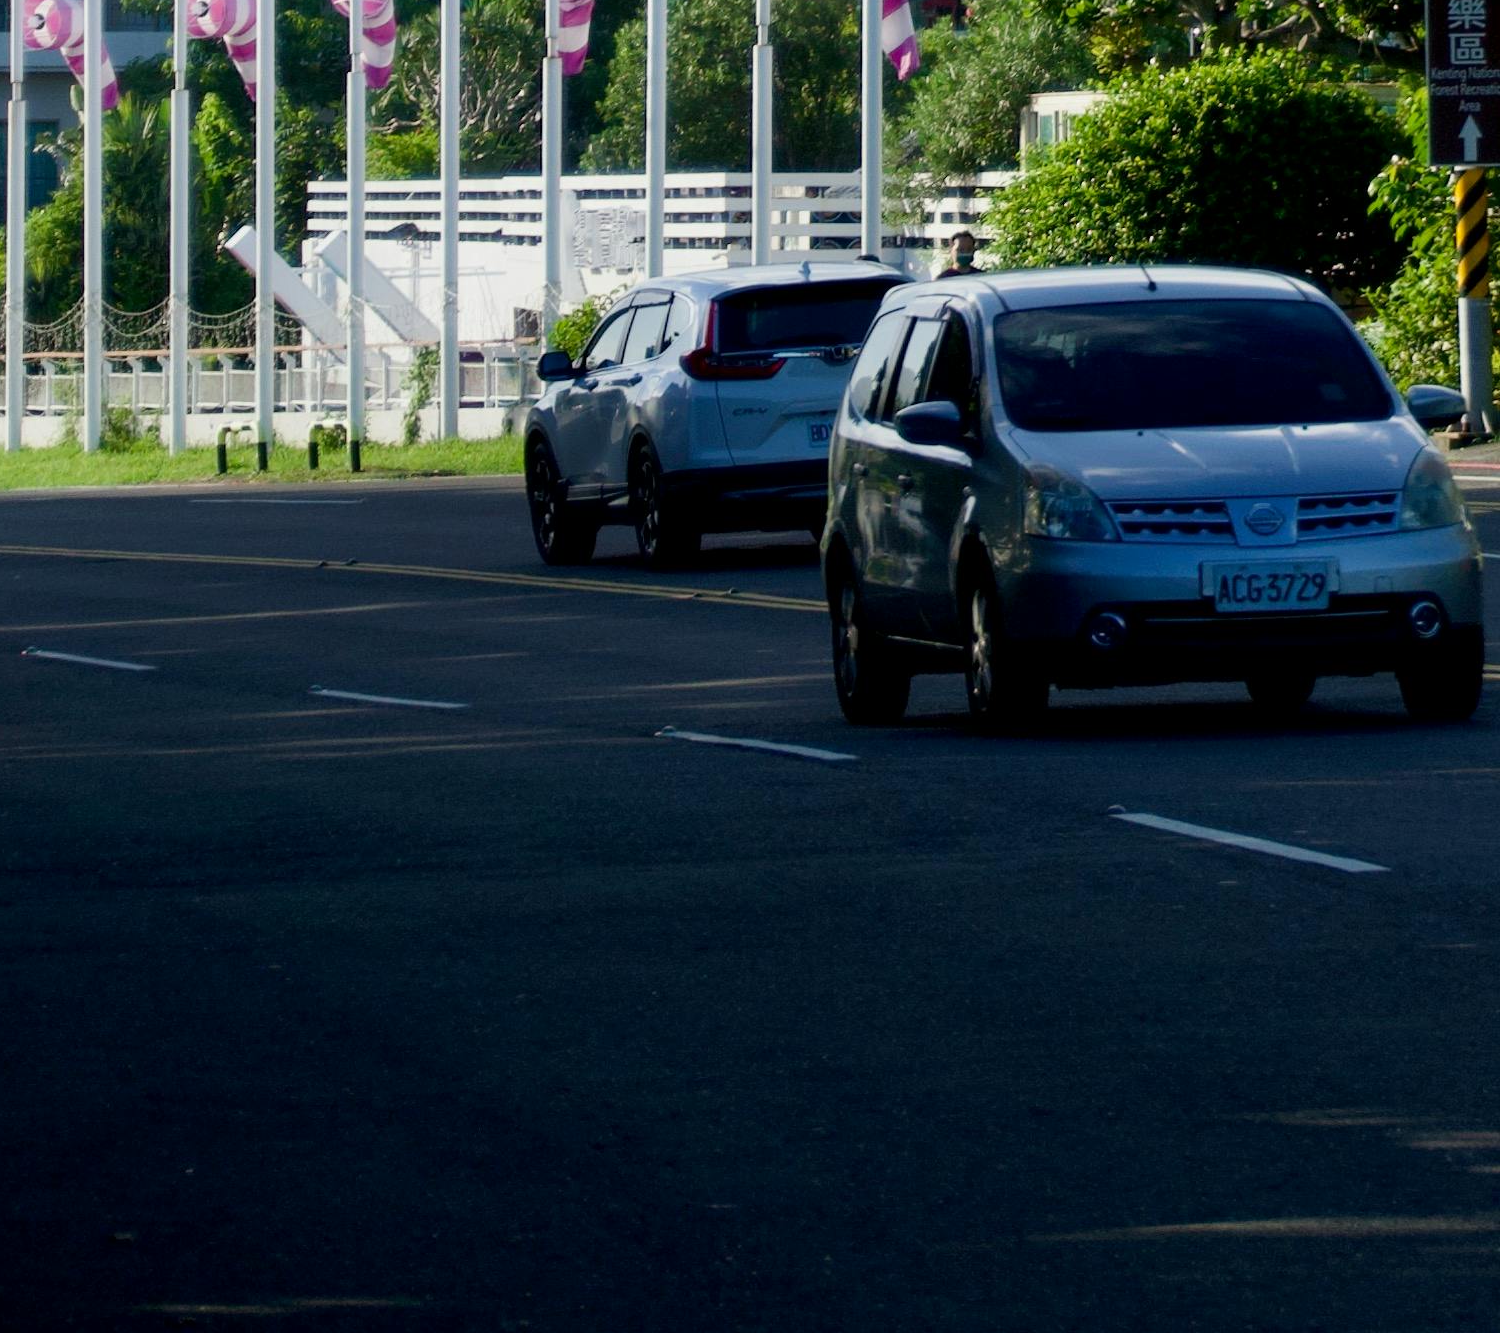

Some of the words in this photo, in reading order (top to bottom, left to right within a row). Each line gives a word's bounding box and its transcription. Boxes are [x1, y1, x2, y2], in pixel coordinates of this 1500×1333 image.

[1431, 67, 1467, 82] Kenting
[1431, 83, 1459, 96] Forest
[1458, 99, 1482, 112] Area
[1217, 572, 1327, 604] ACG-3729
